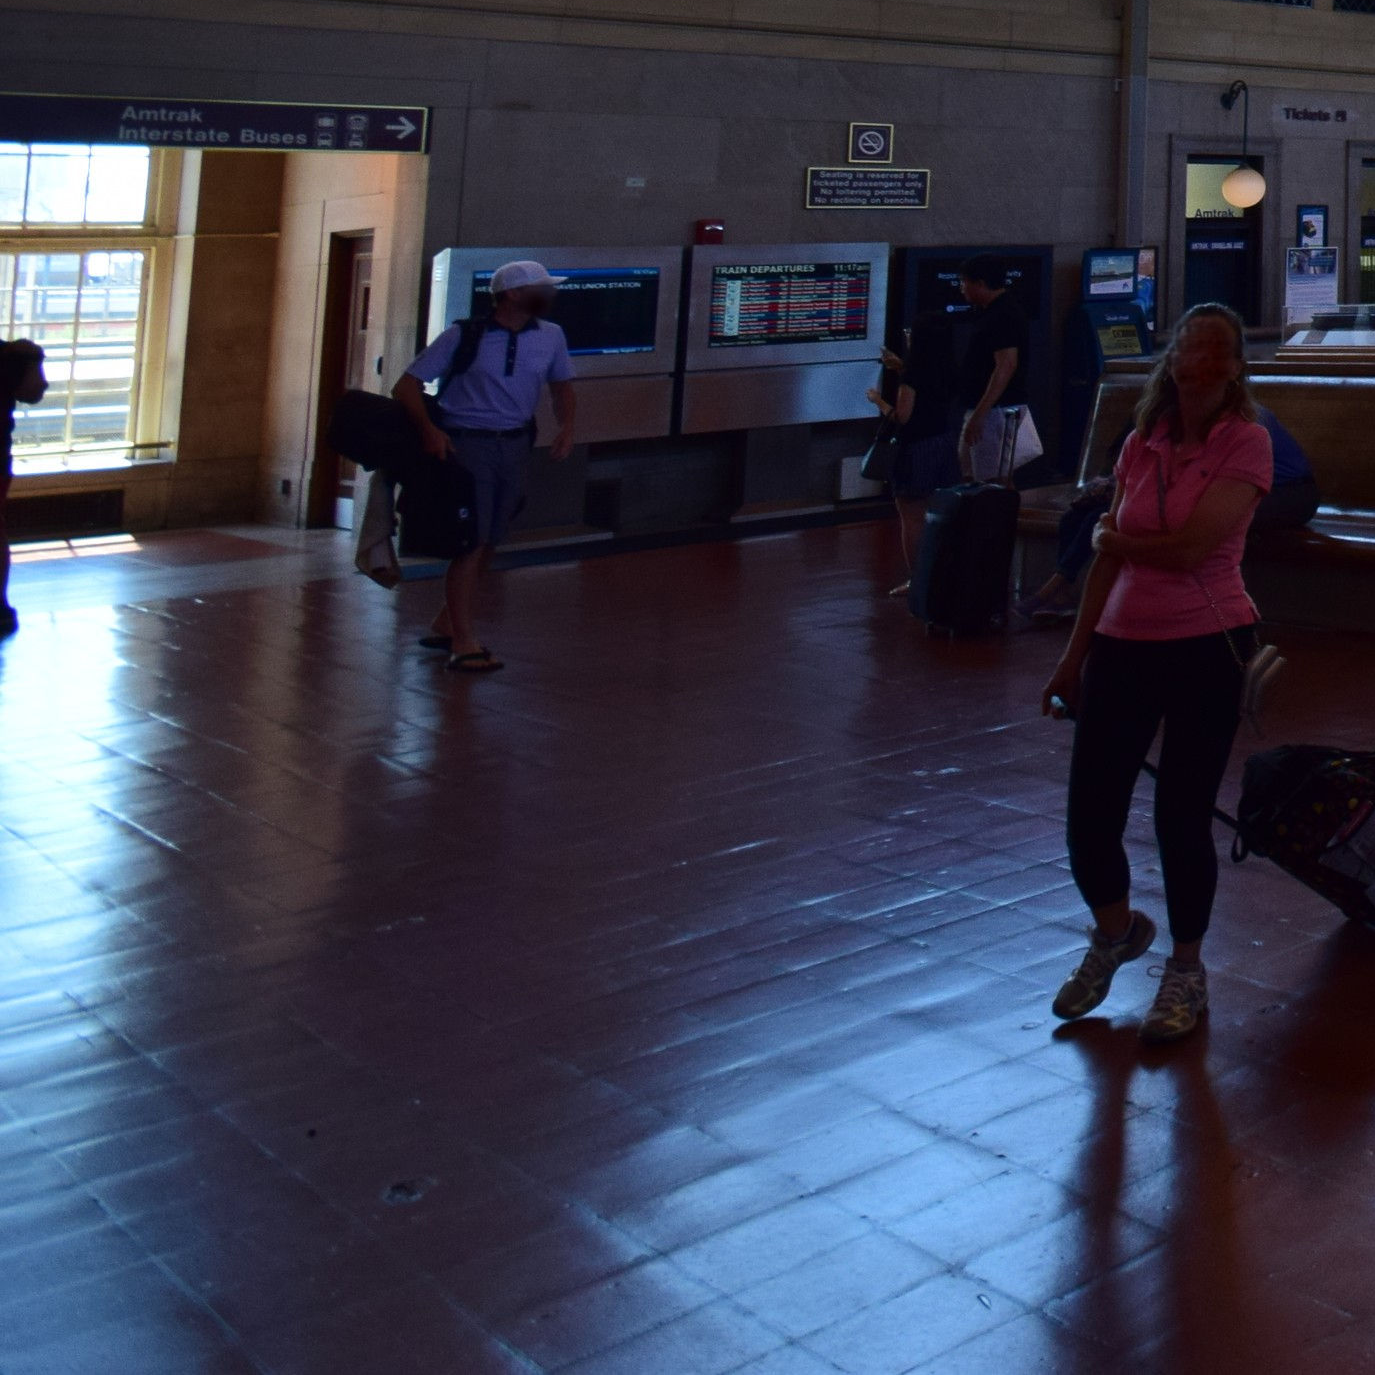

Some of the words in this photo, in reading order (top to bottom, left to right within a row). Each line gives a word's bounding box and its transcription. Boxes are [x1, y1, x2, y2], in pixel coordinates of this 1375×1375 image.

[121, 105, 202, 123] Amtrak
[1284, 107, 1331, 122] Tickets
[118, 124, 230, 144] Interstate
[239, 128, 307, 145] Buses
[819, 171, 854, 180] Seating
[813, 179, 850, 187] ticketed
[852, 180, 902, 188] passengers
[836, 188, 872, 196] loitering
[1194, 208, 1234, 218] Amtrak
[715, 266, 748, 275] TRAIN
[750, 265, 816, 274] DEPARTURES
[608, 281, 642, 289] STATION
